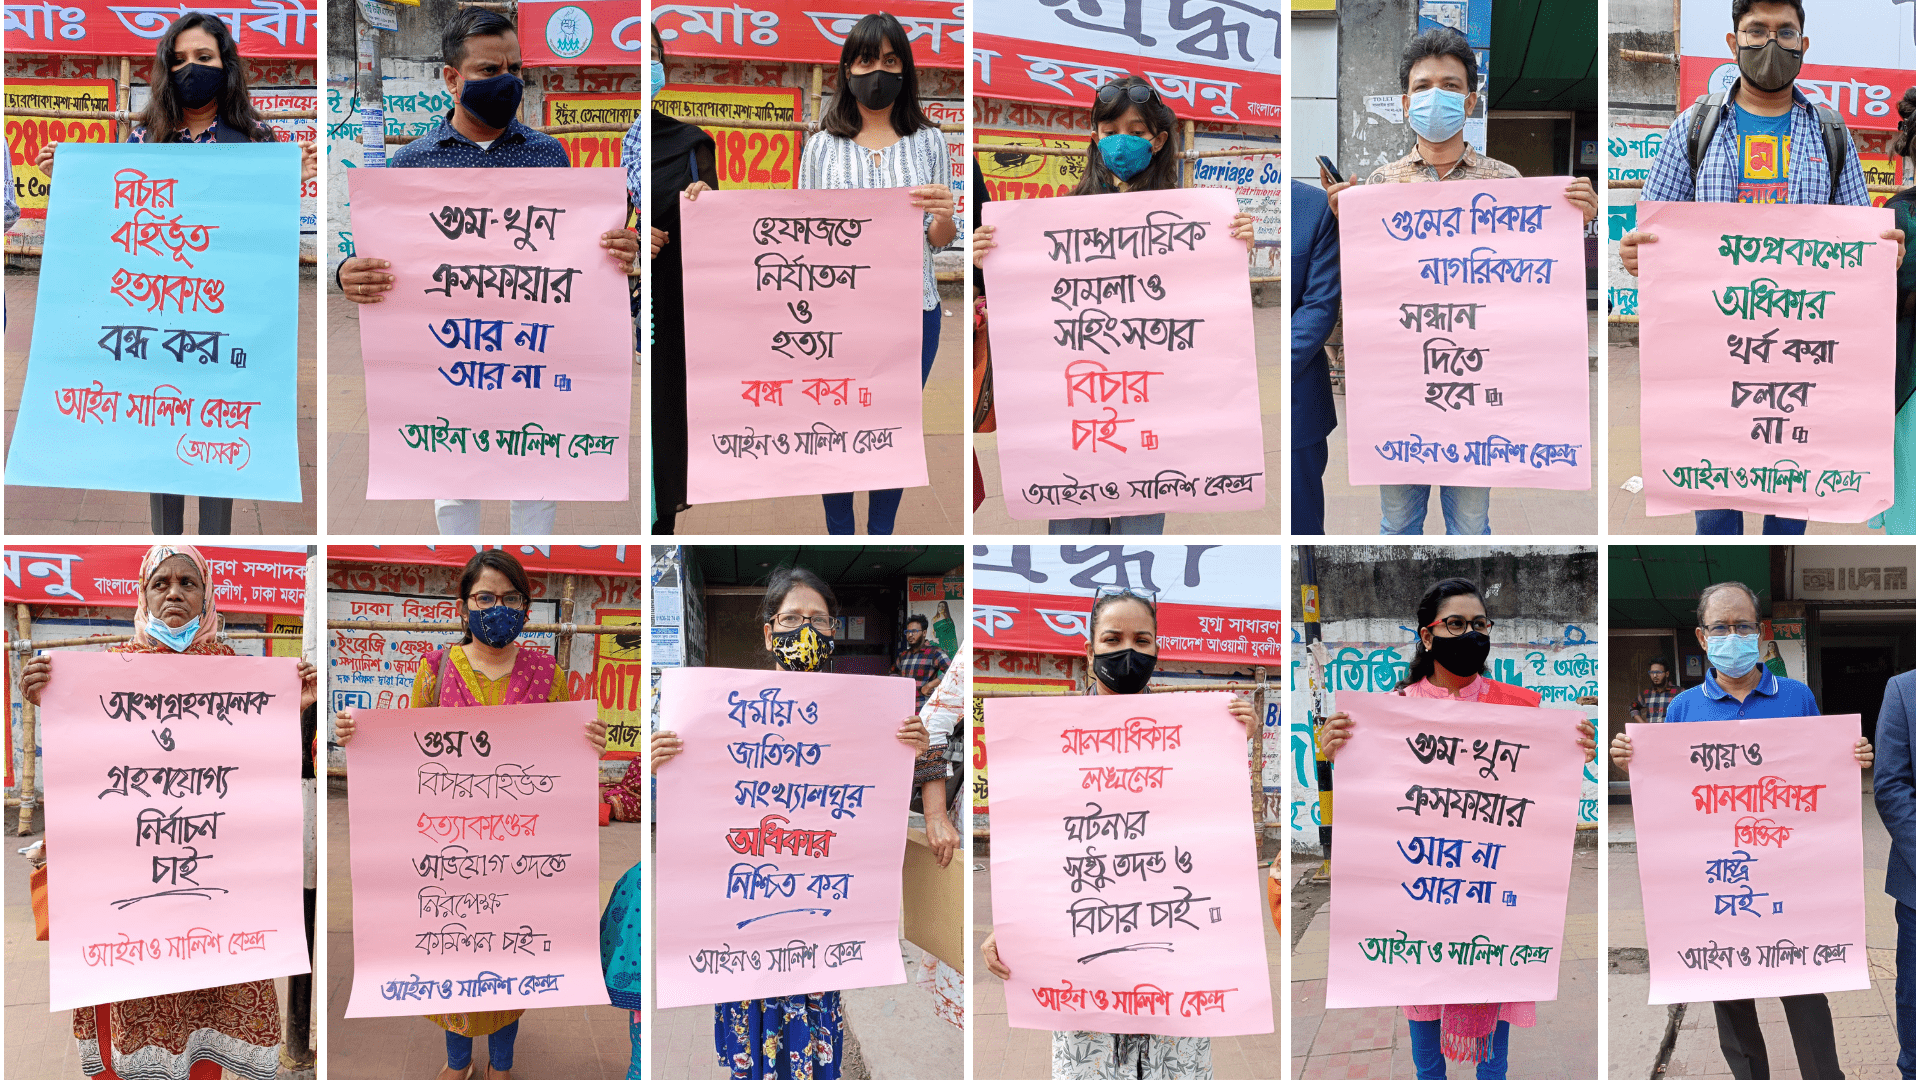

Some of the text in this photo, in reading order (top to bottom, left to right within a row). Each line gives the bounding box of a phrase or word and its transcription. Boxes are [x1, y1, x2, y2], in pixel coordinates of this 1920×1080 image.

[114, 168, 178, 209] বিচার
[753, 217, 872, 247] হেফাজতে
[1382, 207, 1465, 241] গুমের
[1469, 193, 1552, 234] শিকার
[110, 208, 220, 269] বহির্ভূত
[1044, 210, 1211, 264] সাম্প্রদায়িক
[1718, 234, 1877, 269] মতপ্রকাশের
[424, 264, 583, 304] ক্রসফায়ার
[754, 252, 871, 291] নির্যাতন
[1418, 247, 1558, 285] নাগরিকদের
[110, 268, 225, 315] হত্যাকাণ্ড
[1051, 274, 1137, 311] হামলা
[1712, 278, 1835, 320] অধিকার
[787, 300, 812, 324] ও
[1399, 303, 1486, 332] সন্ধান
[98, 325, 229, 365] বন্ধ কর
[428, 318, 555, 353] আর না
[771, 331, 842, 360] হত্যা
[1053, 308, 1205, 355] সহিংসতার
[1727, 328, 1839, 365] খর্ব করা
[1423, 337, 1490, 376] দিতে
[438, 361, 547, 390] আর না
[742, 378, 855, 407] বন্ধ কর
[1065, 360, 1164, 407] বিচার
[55, 380, 261, 429] আইন সালিশ কেন্দ্র
[1425, 382, 1481, 412] হবে
[1731, 381, 1816, 413] চলবে
[398, 416, 472, 454] আইন
[496, 422, 566, 458] সালিশ
[568, 434, 619, 458] কেন্দ্র
[712, 426, 772, 459] আইন
[794, 422, 848, 455] সালিশ
[853, 427, 902, 454] কেন্দ্র
[1072, 407, 1135, 453] চাই
[1751, 417, 1790, 444] না
[1375, 433, 1441, 464] আইন
[1464, 435, 1528, 466] সালিশ
[1530, 443, 1582, 468] কেন্দ্র
[1022, 473, 1099, 505] আইন
[1127, 470, 1200, 499] সালিশ
[1204, 472, 1262, 496] কেন্দ্র
[1662, 459, 1731, 490] আইন
[1750, 459, 1811, 493] সালিশ
[1815, 470, 1870, 497] কেন্দ্র
[350, 600, 394, 617] ঢাকা
[152, 727, 175, 752] ও
[414, 731, 468, 757] গুম
[727, 733, 831, 769] জাতিগত
[1060, 717, 1183, 755] মানবাধিকার
[1690, 743, 1741, 772] ন্যায়
[1396, 784, 1535, 828] ক্রসফায়ার
[1692, 776, 1826, 814] মানবাধিকার
[136, 806, 226, 847] নির্বাচন
[417, 812, 539, 843] হত্যাকাণ্ডের
[725, 814, 837, 859] অধিকার
[1063, 802, 1150, 843] ঘটনার
[152, 846, 213, 886] চাই
[412, 845, 509, 881] অভিযোগ
[1397, 836, 1506, 870] আর না
[726, 862, 854, 900] নিশ্চিত কর
[1401, 876, 1497, 905] আর না
[418, 886, 509, 918] নিরপেক্ষ
[1066, 886, 1211, 937] বিচার চাই
[83, 933, 144, 967] আইন
[166, 927, 223, 960] সালিশ
[228, 930, 277, 954] কেন্দ্র
[415, 923, 548, 956] কমিশন চাই
[689, 943, 747, 974] আইন
[766, 940, 818, 972] সালিশ
[825, 941, 866, 968] কেন্দ্র
[1358, 929, 1427, 965] আইন
[1448, 934, 1509, 966] সালিশ
[1510, 945, 1553, 966] কেন্দ্র
[1677, 940, 1735, 970] আইন
[1756, 939, 1809, 968] সালিশ
[1813, 943, 1853, 966] কেন্দ্র
[381, 974, 441, 1000] আইন
[457, 971, 517, 999] সালিশ
[518, 974, 564, 995] কেন্দ্র
[1032, 979, 1088, 1011] আইন
[1111, 983, 1174, 1015] সালিশ
[1180, 988, 1238, 1017] কেন্দ্র
